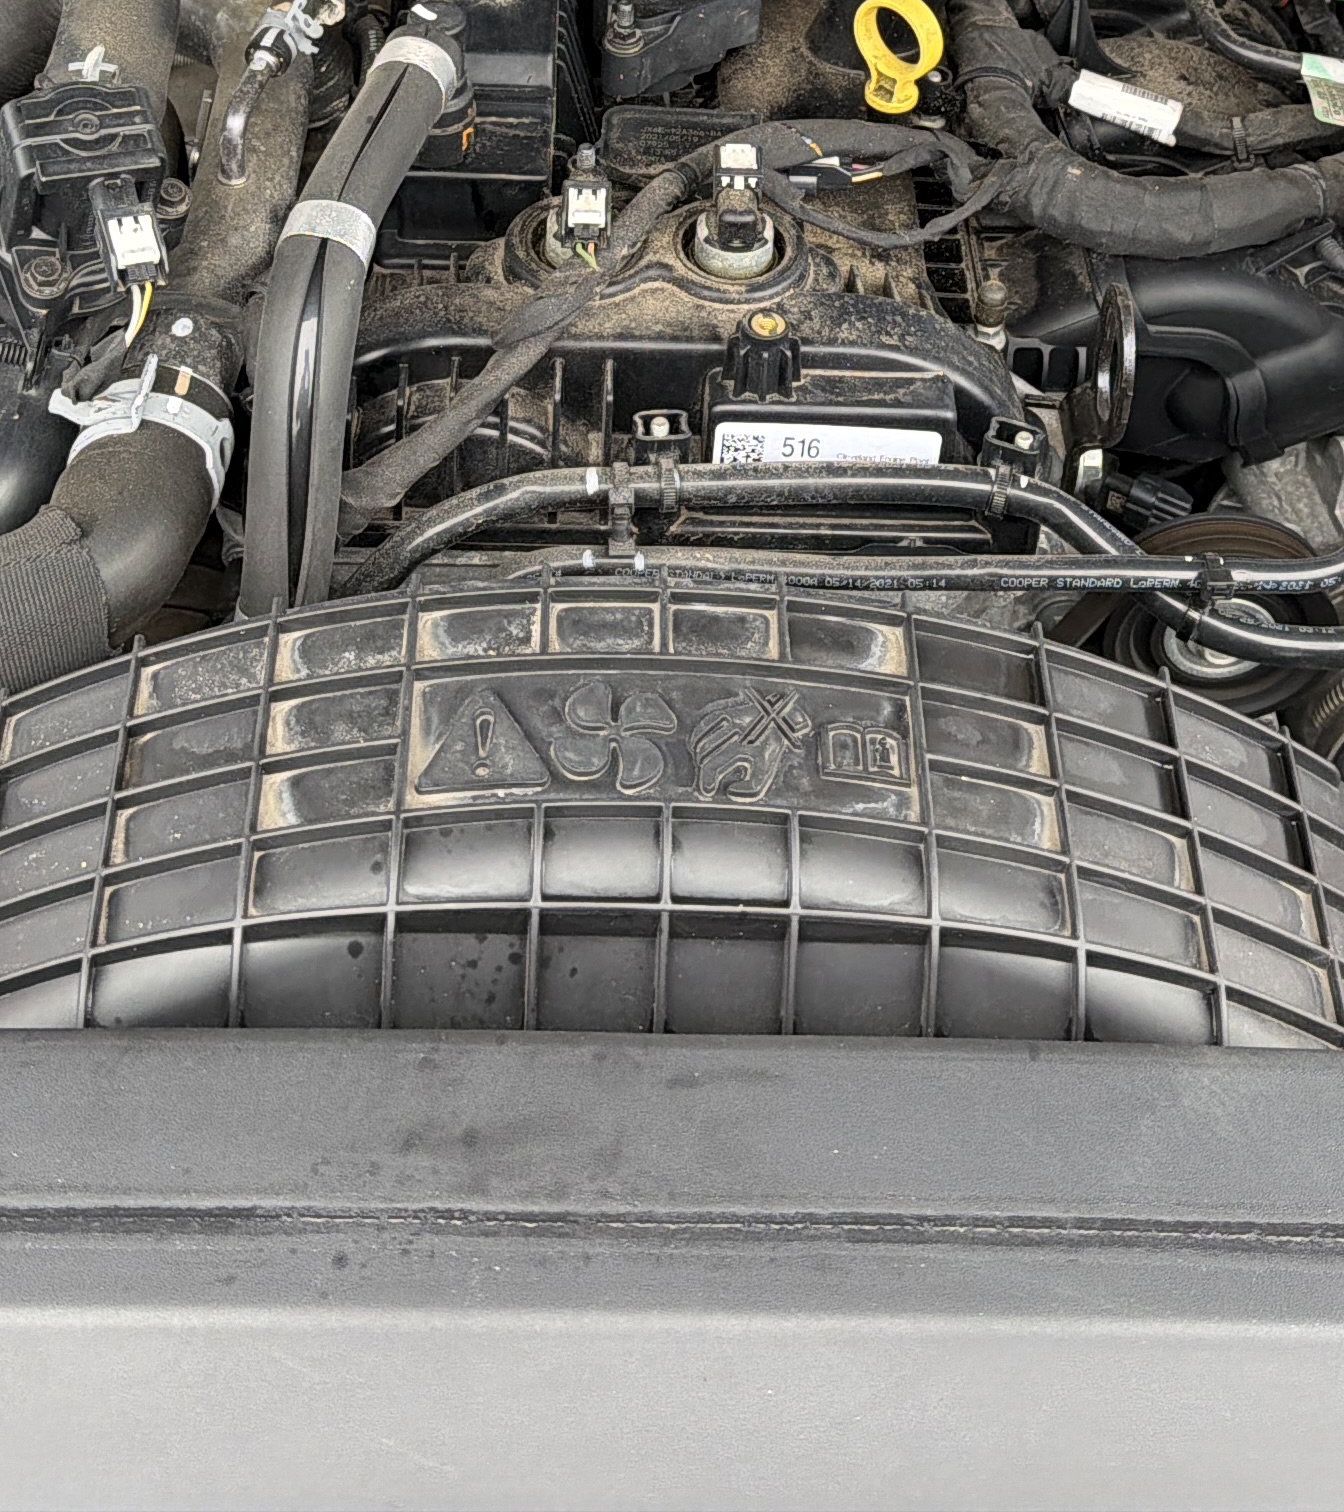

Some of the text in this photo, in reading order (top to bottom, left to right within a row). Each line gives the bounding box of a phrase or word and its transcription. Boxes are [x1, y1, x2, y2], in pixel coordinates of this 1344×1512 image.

[780, 436, 821, 459] 516
[1000, 576, 1049, 588] COOPER
[1056, 576, 1123, 588] STANDARD
